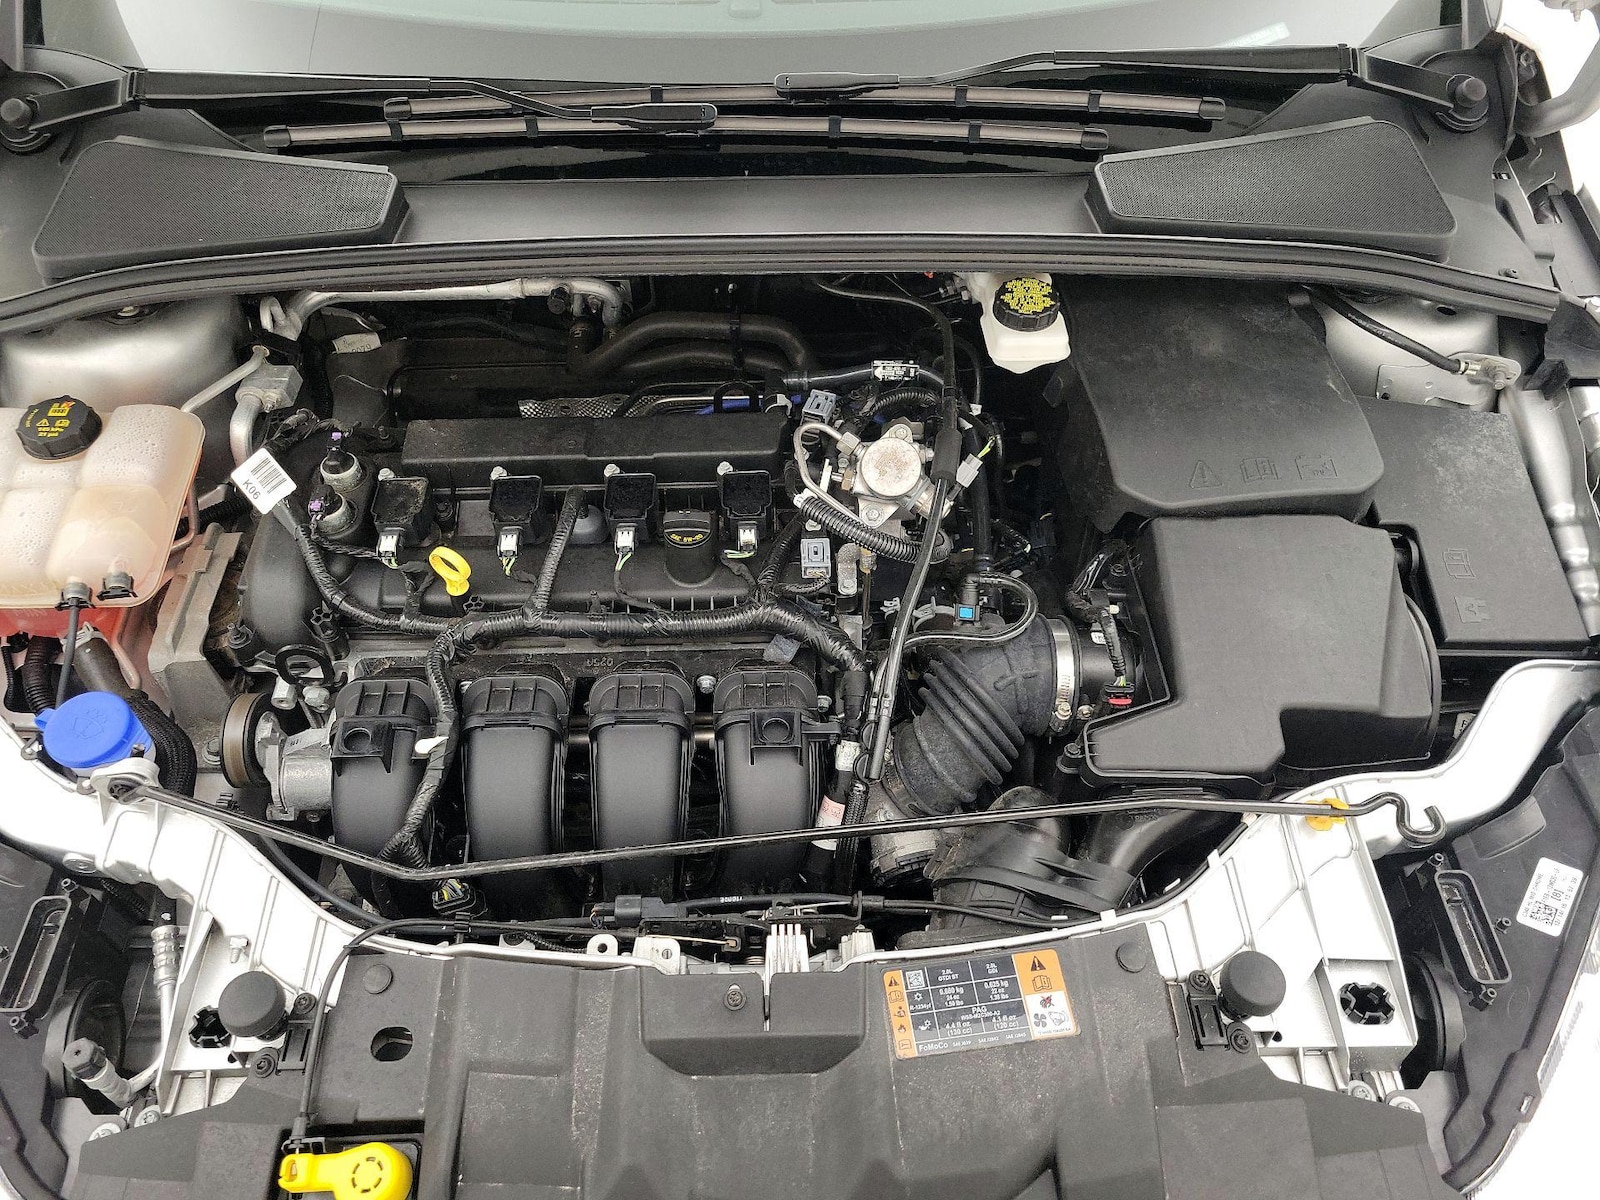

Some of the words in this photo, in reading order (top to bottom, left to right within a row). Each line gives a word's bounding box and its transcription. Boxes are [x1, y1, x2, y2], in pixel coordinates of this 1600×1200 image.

[242, 479, 261, 500] K06
[1000, 980, 1009, 988] kg
[956, 986, 964, 994] kg
[972, 1006, 988, 1014] PAG
[918, 1042, 949, 1052] FoMoCo
